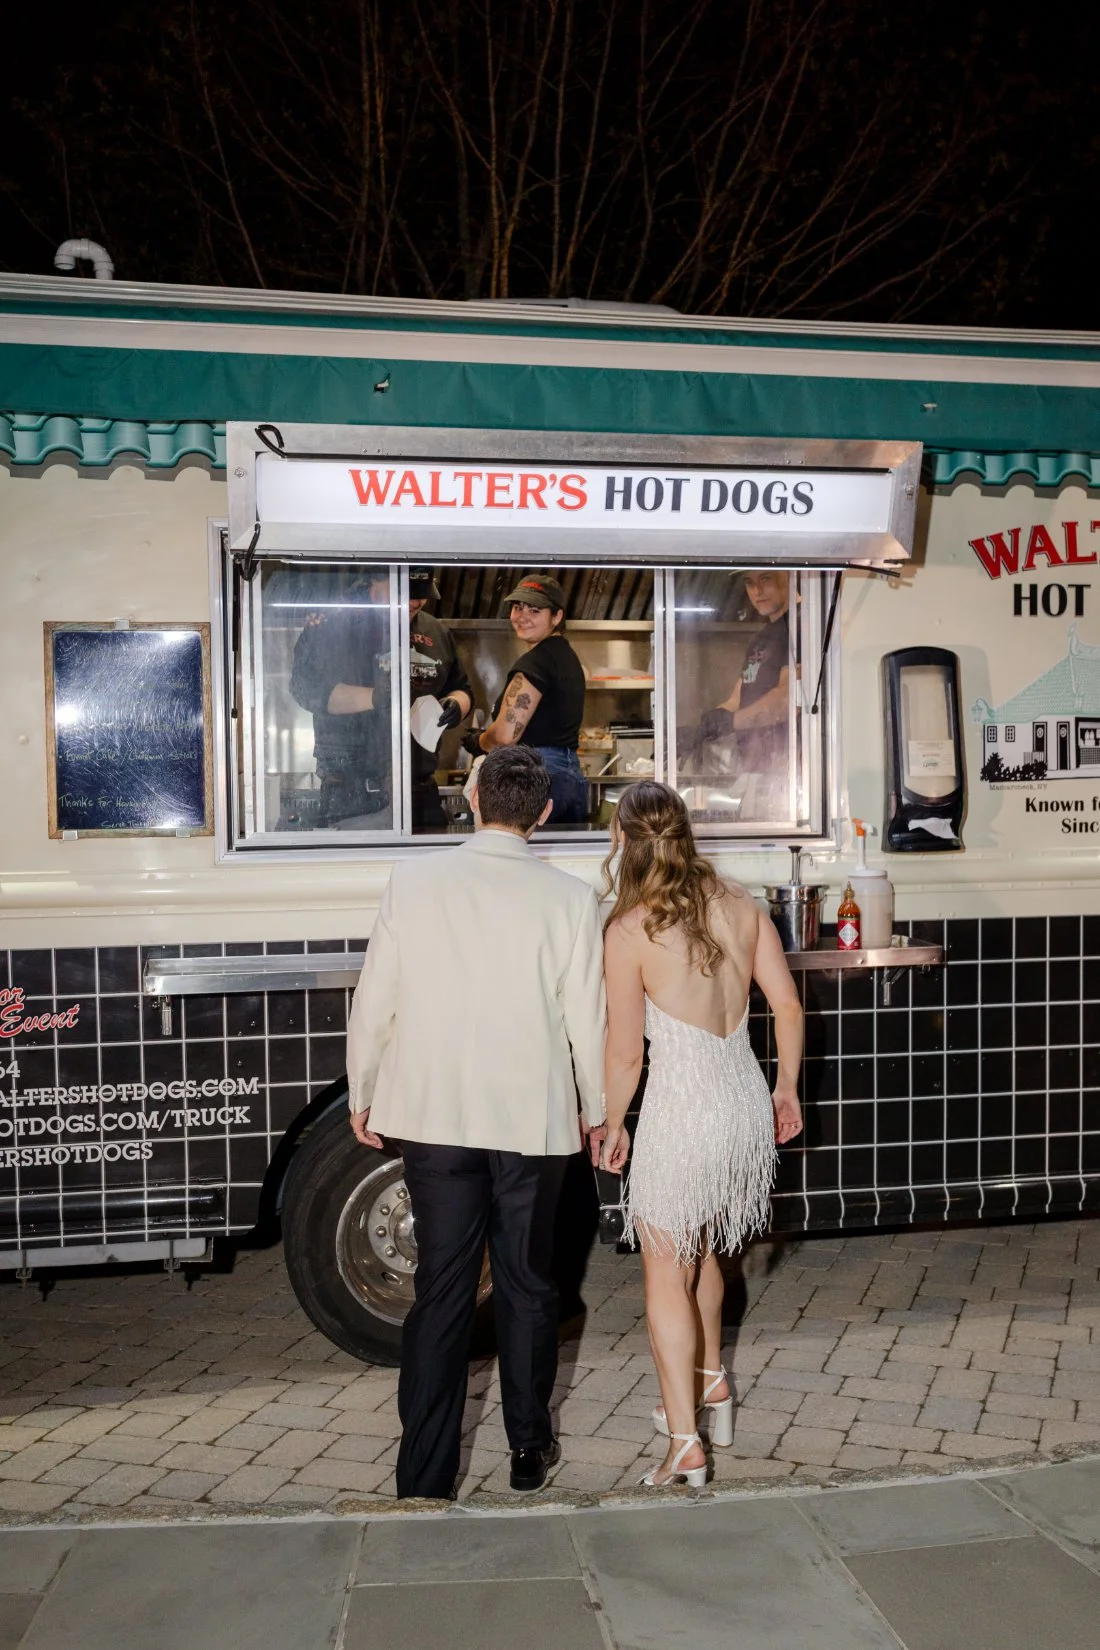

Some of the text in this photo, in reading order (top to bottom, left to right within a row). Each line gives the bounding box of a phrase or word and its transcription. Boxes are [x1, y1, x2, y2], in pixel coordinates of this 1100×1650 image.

[348, 469, 814, 516] WALTER'S HOT DOGS
[1013, 583, 1092, 617] HOT
[1025, 796, 1100, 812] Known f
[0, 1003, 80, 1038] Event
[0, 1106, 251, 1138] OTDOGS.COM/TRUCK
